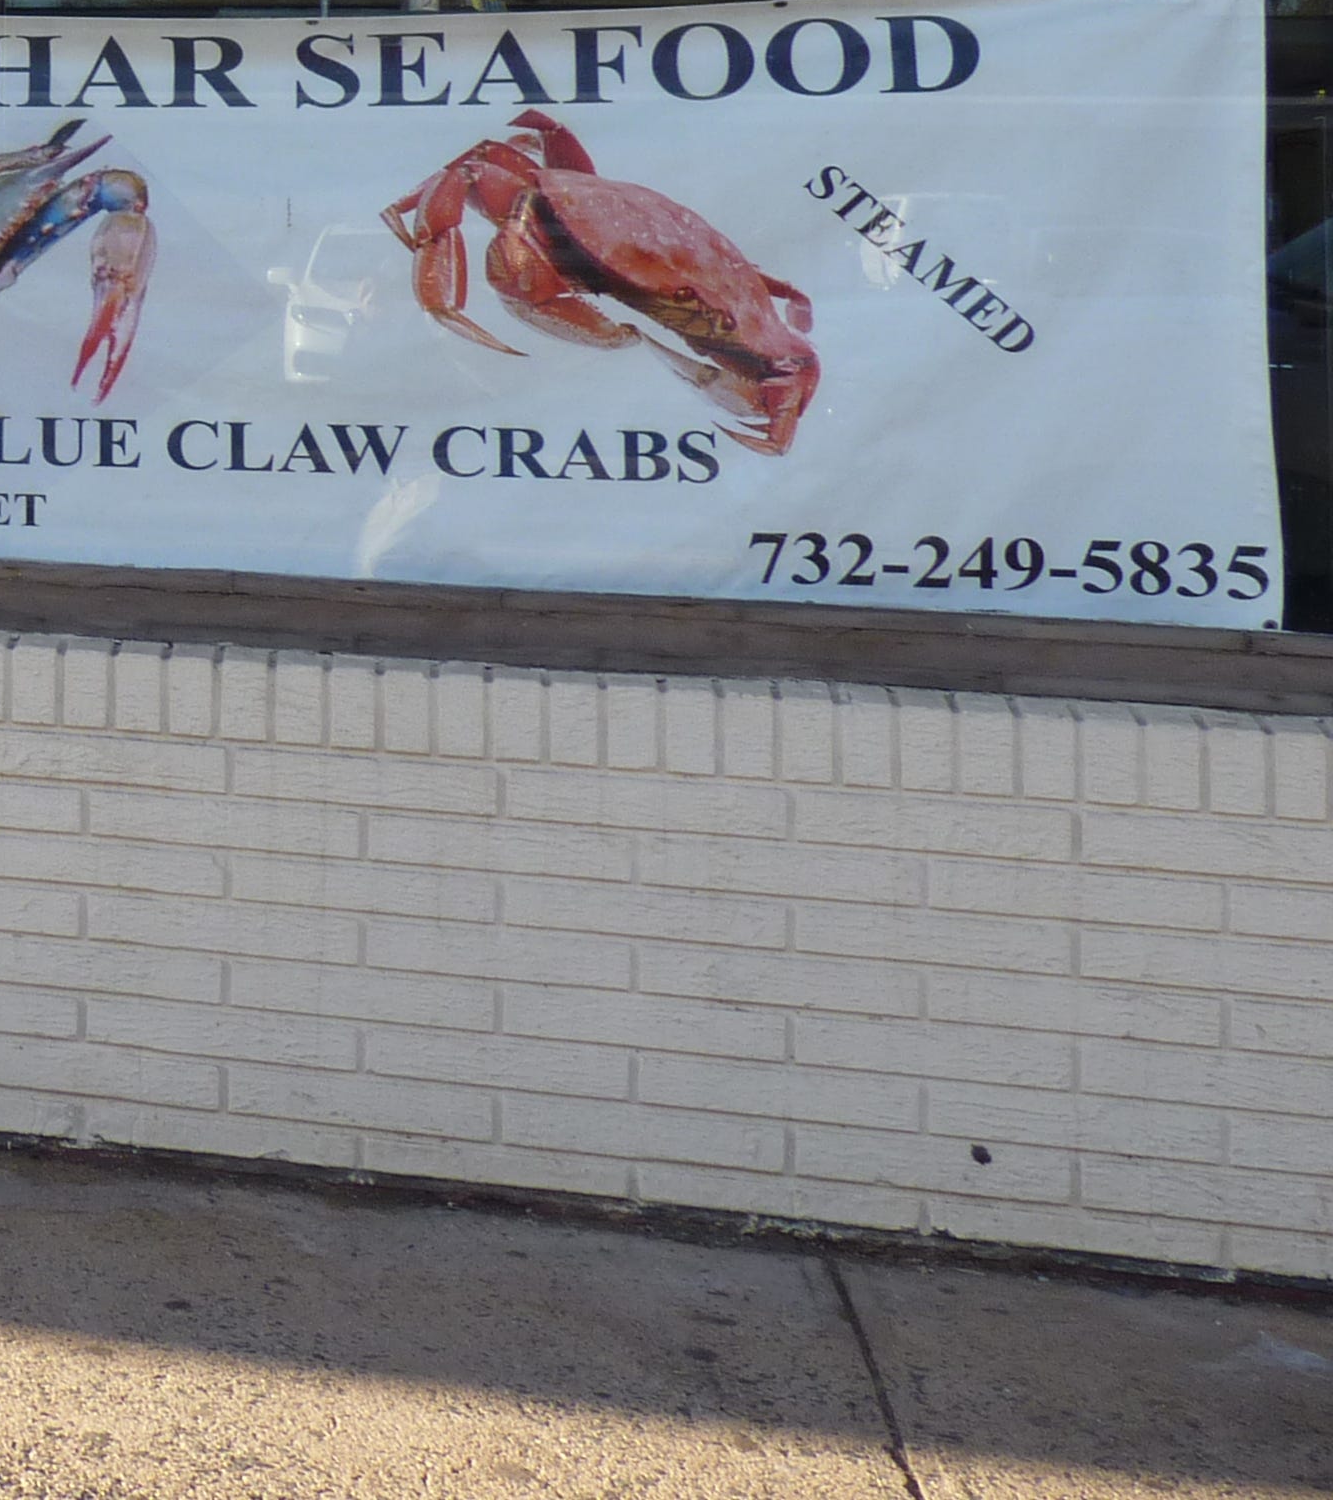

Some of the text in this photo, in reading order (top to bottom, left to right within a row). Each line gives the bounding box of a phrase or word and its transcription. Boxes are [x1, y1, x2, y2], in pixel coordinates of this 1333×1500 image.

[295, 13, 981, 109] SEAFOOD
[803, 164, 1036, 355] STEAMED
[166, 420, 410, 477] CLAW
[432, 425, 721, 483] CRABS
[747, 530, 1272, 601] 732-249-5835
